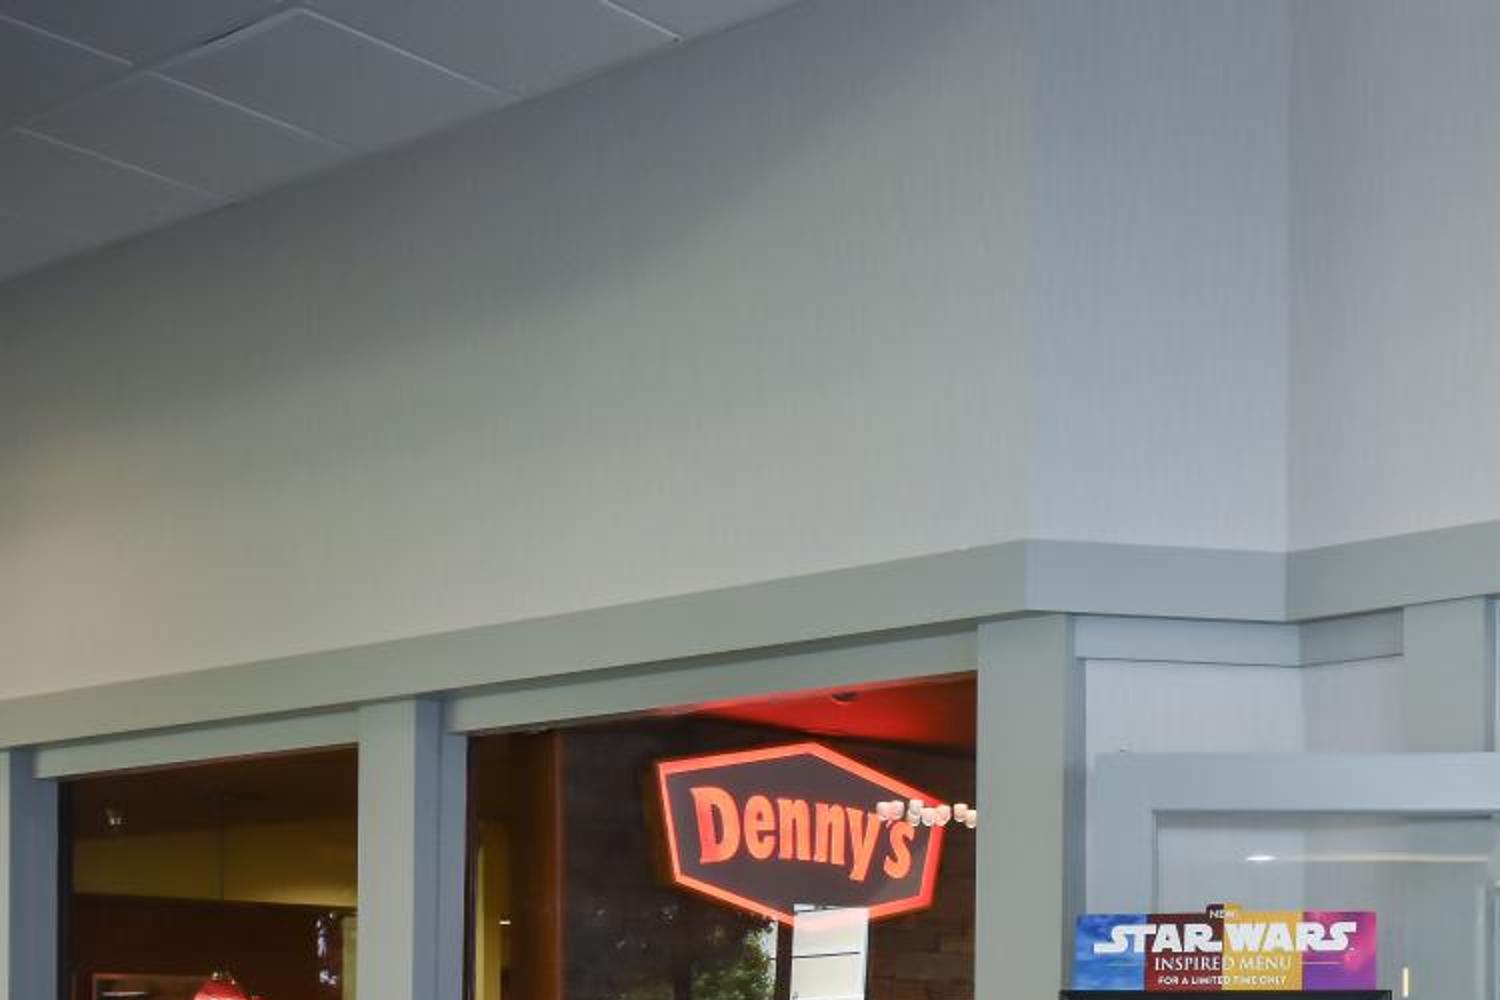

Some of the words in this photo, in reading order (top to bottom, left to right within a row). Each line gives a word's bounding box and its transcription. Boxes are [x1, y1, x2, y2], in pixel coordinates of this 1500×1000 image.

[689, 785, 915, 881] Denny's
[1093, 923, 1222, 954] STAR
[1223, 921, 1356, 953] WARS
[1155, 956, 1235, 972] INSPIRED
[1239, 955, 1292, 971] MENU
[1158, 975, 1178, 986] FOR
[1181, 975, 1189, 985] A
[1191, 975, 1231, 985] LIMITED
[1233, 975, 1257, 985] TIME
[1259, 975, 1287, 985] ONLY
